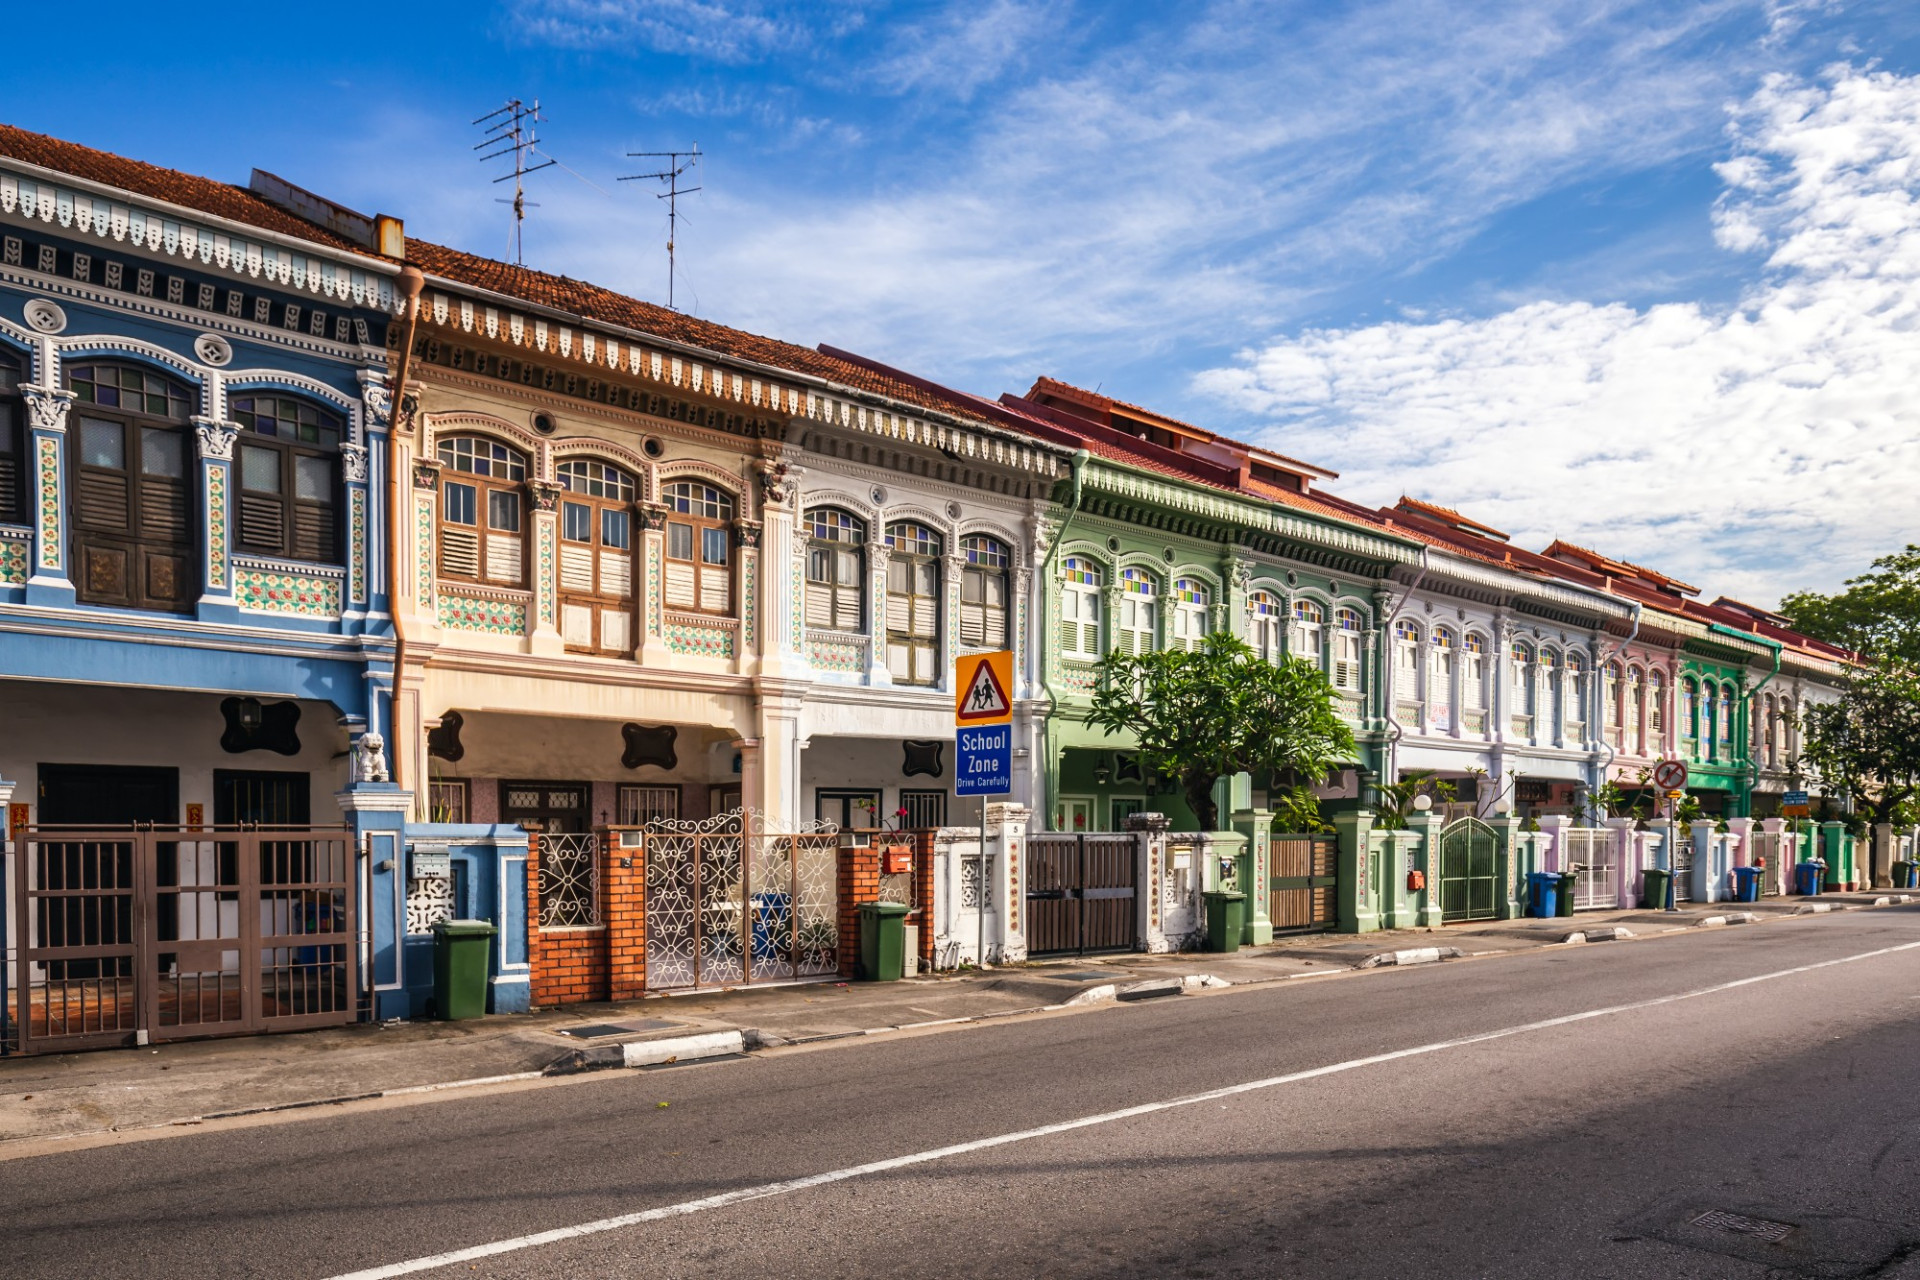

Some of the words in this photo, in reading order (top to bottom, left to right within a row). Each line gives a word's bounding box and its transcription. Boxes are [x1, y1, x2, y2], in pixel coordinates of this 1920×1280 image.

[962, 731, 1005, 751] School
[968, 755, 999, 773] Zone
[957, 778, 975, 787] Drive
[977, 776, 1009, 788] Carefully
[1013, 825, 1019, 834] 5
[624, 857, 631, 867] 3
